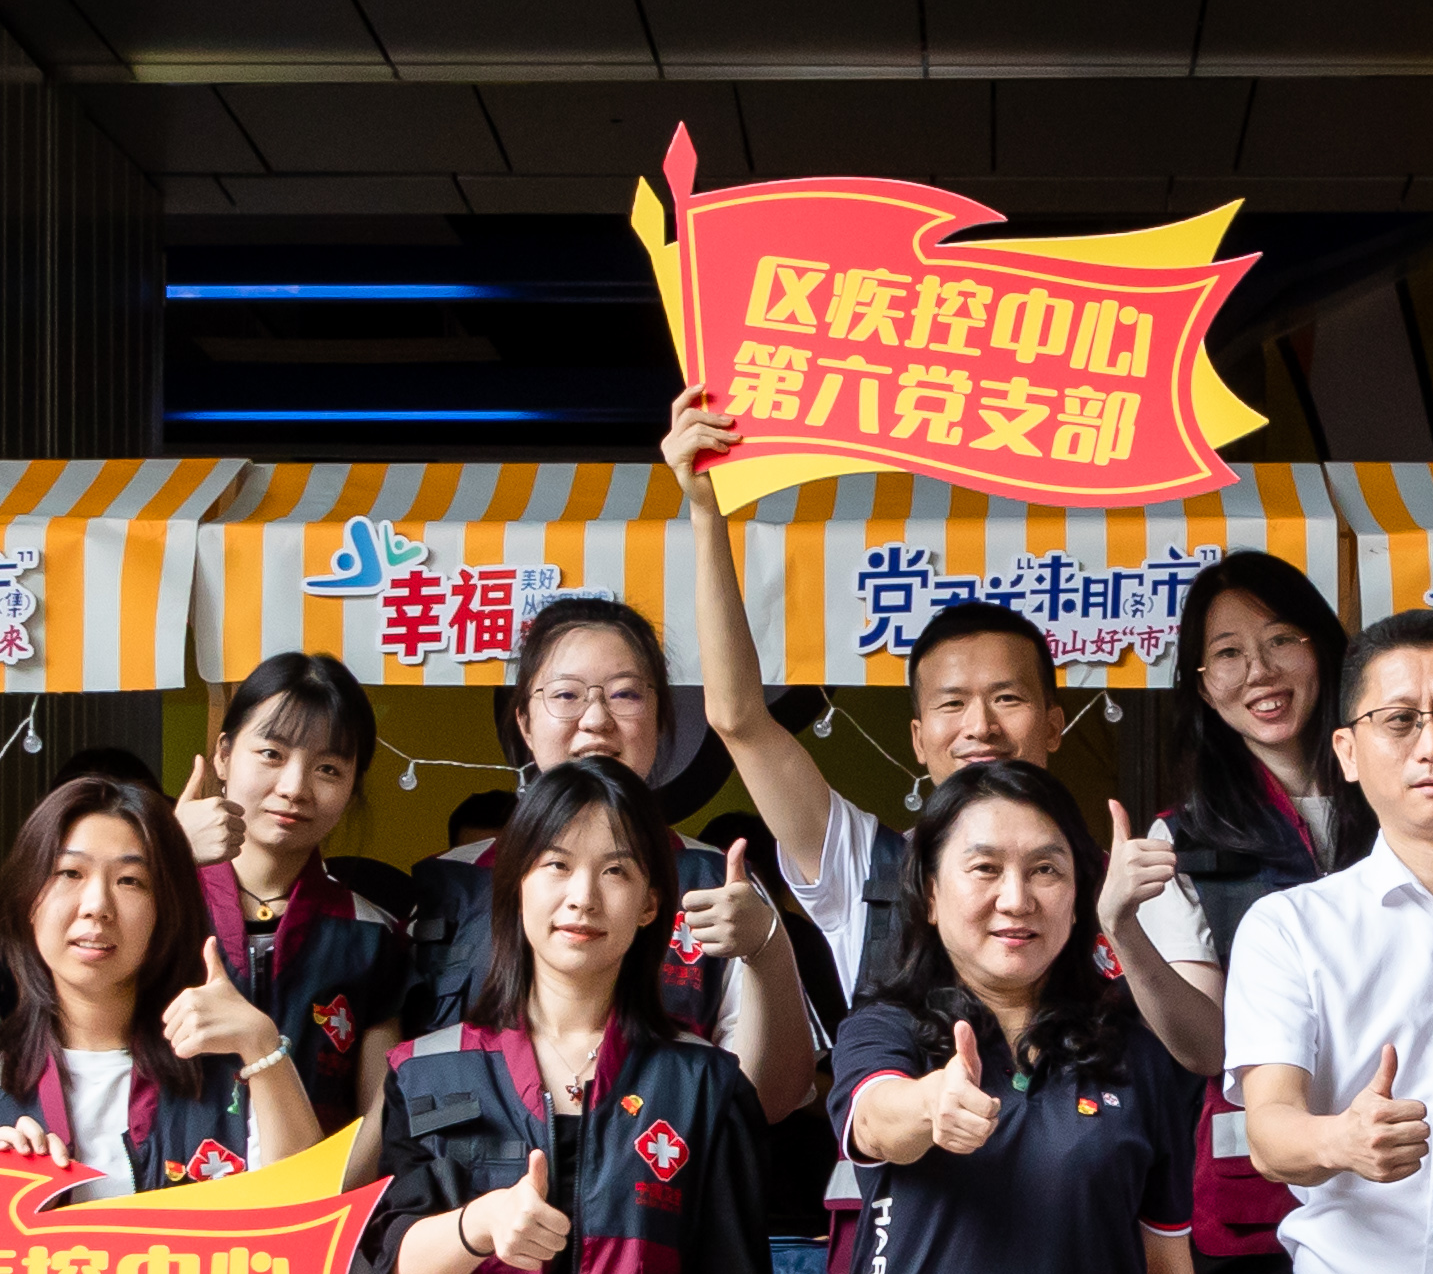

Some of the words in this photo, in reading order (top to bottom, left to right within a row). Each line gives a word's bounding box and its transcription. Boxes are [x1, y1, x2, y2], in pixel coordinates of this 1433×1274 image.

[744, 255, 1154, 378] 区疾控中心
[724, 341, 1142, 467] 第六党支部
[381, 569, 518, 657] 幸福
[521, 569, 555, 591] 美好
